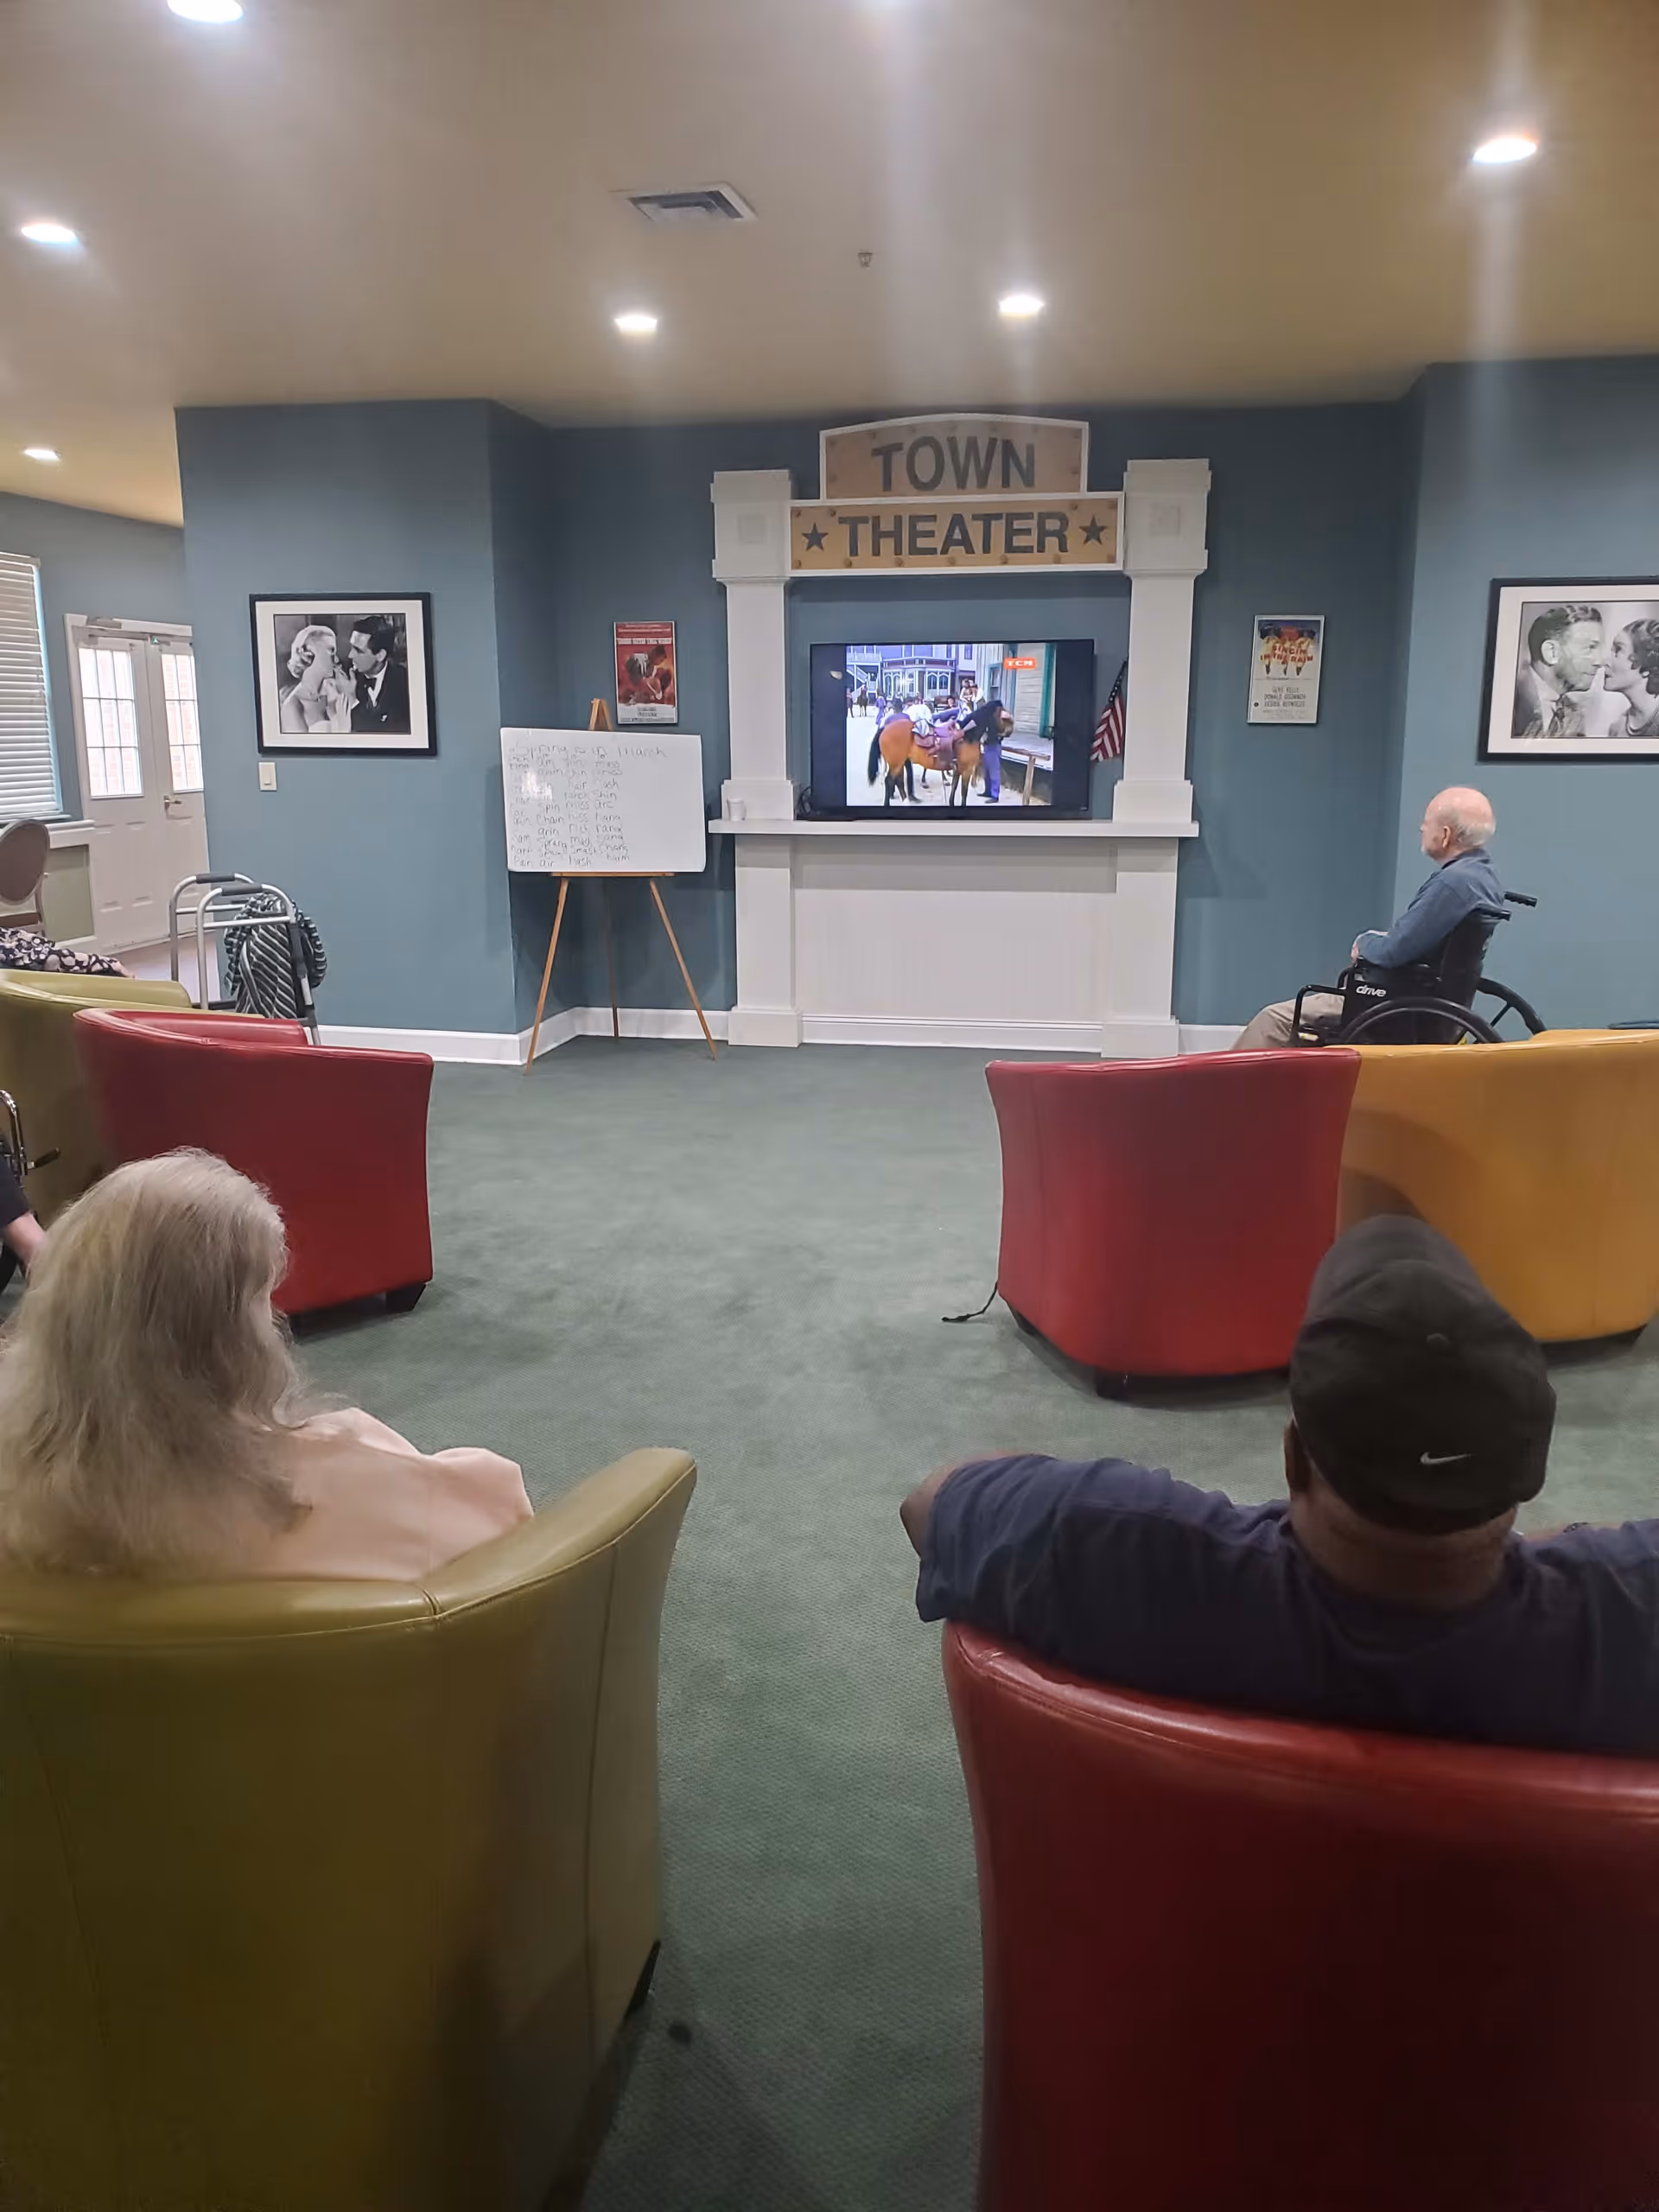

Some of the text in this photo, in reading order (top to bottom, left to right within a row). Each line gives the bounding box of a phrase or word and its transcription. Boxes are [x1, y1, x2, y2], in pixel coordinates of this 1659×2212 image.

[870, 435, 1035, 492] TOWN
[838, 512, 1070, 557] THEATER
[1356, 984, 1386, 997] drive
